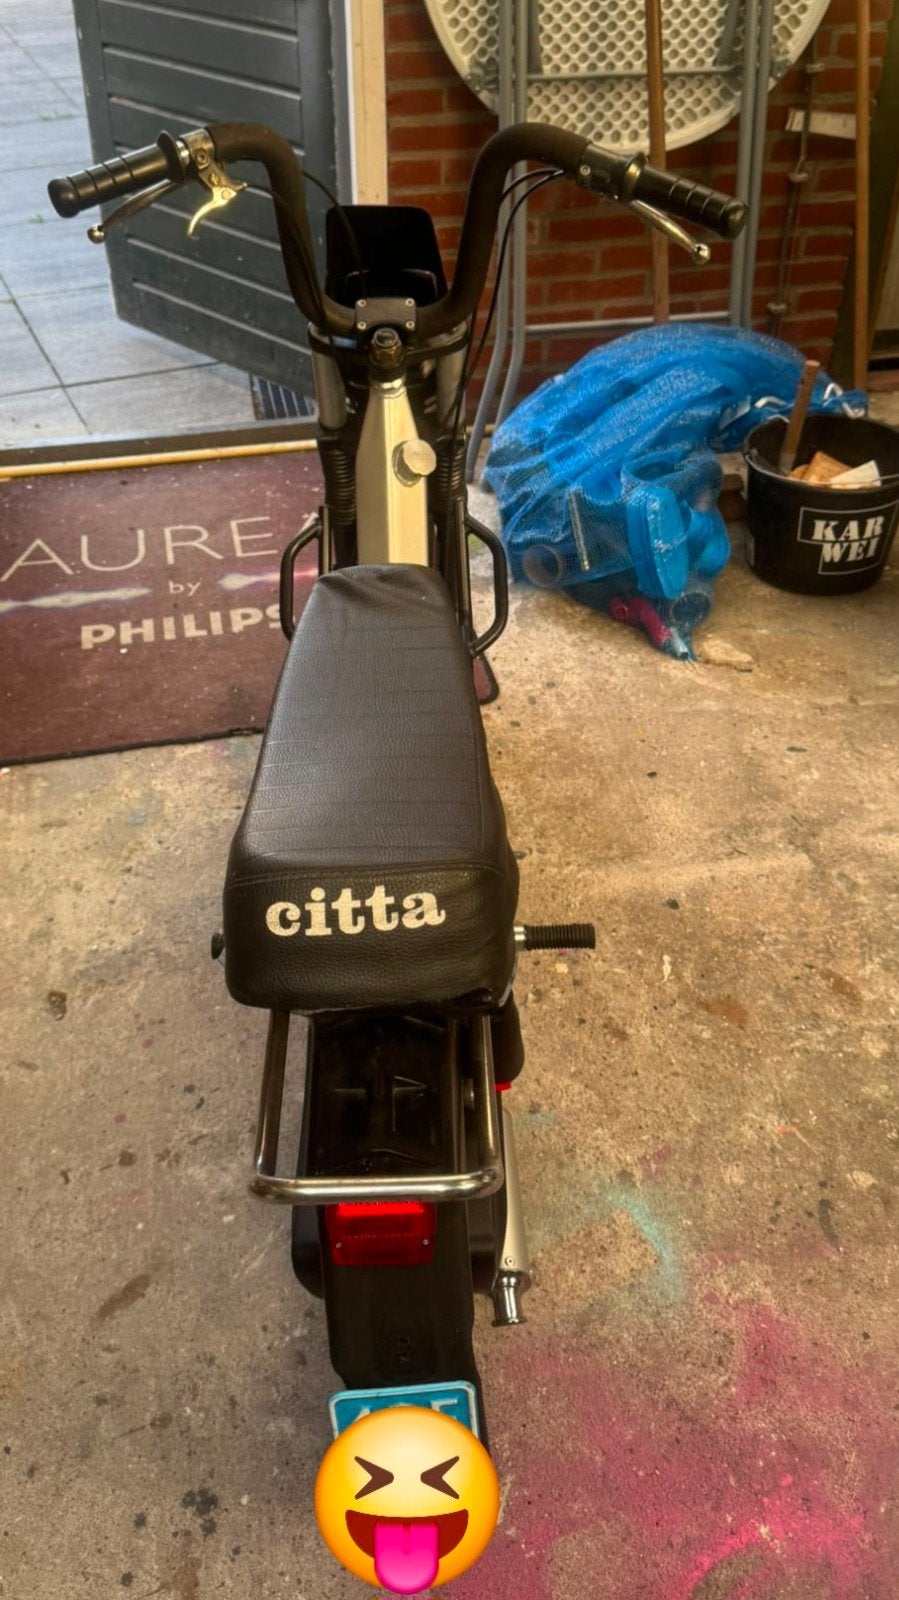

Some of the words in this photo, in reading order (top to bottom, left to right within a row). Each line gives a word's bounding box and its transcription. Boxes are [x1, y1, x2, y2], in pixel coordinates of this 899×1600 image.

[811, 516, 885, 541] KAR
[0, 512, 319, 583] AURE
[821, 537, 880, 563] WEI
[168, 581, 201, 596] by
[265, 885, 446, 937] citta
